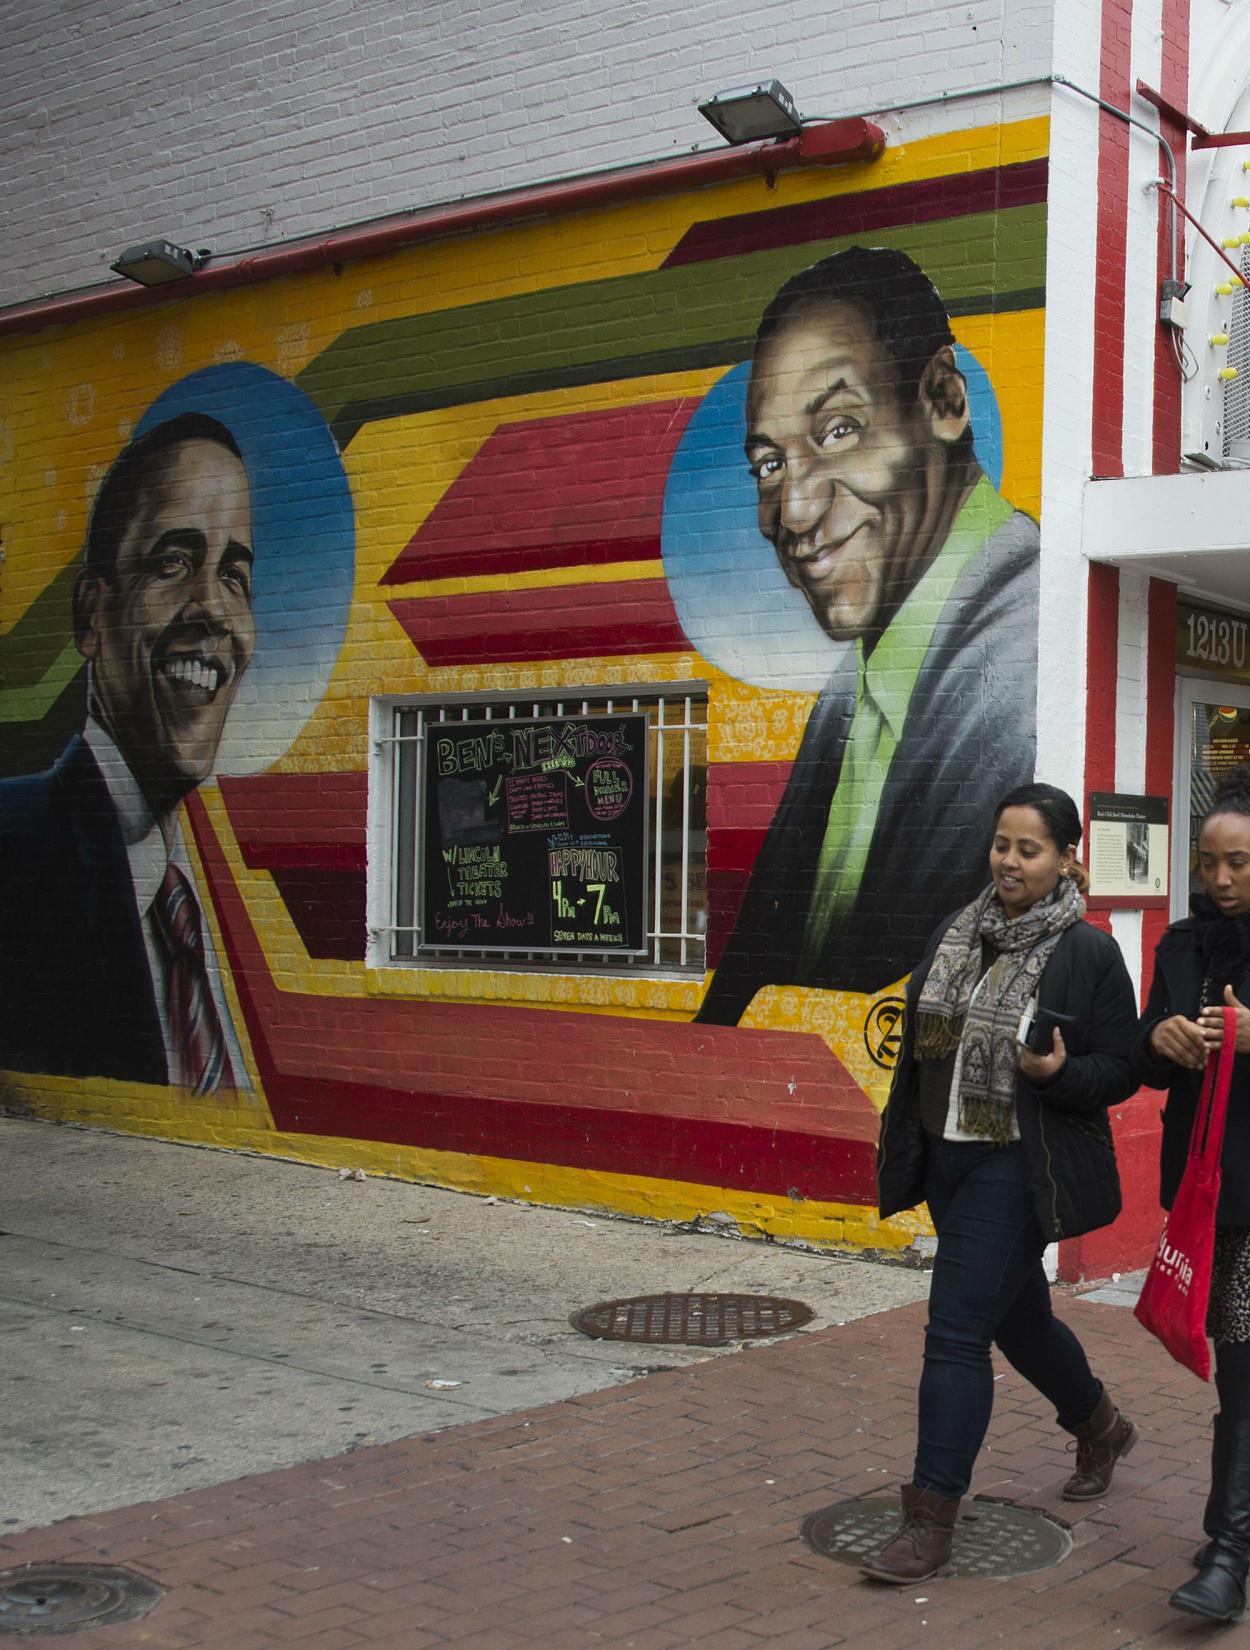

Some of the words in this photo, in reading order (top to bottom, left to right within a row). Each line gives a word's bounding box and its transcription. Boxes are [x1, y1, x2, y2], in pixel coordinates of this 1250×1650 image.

[592, 769, 620, 785] FULL
[597, 793, 622, 805] MENU
[458, 845, 500, 864] LINCOLN
[457, 861, 508, 881] THEATER
[456, 880, 502, 898] TICKETS
[435, 912, 468, 937] Enjoy
[470, 913, 492, 928] The
[554, 930, 575, 942] SEVEN
[577, 932, 593, 942] DAYS
